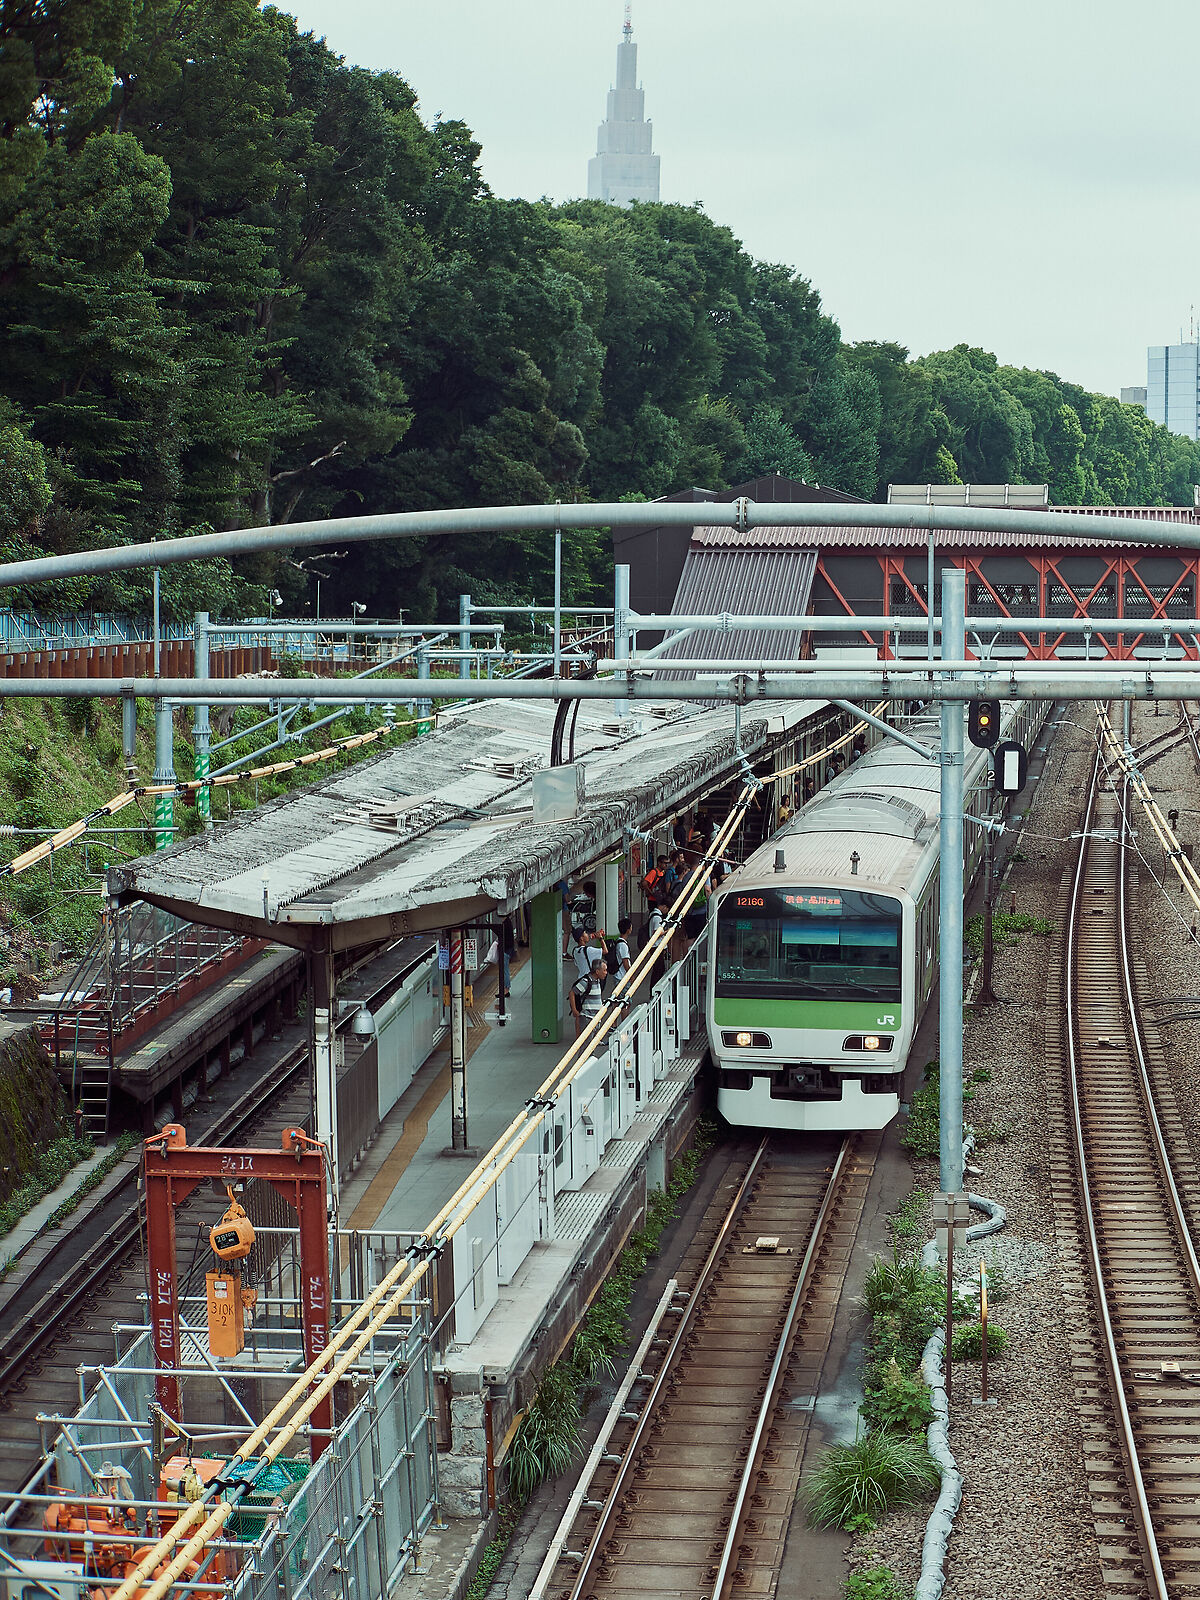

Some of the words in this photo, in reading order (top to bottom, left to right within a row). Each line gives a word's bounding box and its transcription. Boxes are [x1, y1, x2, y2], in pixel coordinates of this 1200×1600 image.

[987, 770, 995, 781] 2
[737, 897, 764, 906] 1216G
[877, 1015, 895, 1026] JR
[210, 1301, 234, 1316] 310K
[158, 1318, 174, 1348] H20
[310, 1324, 326, 1354] H20
